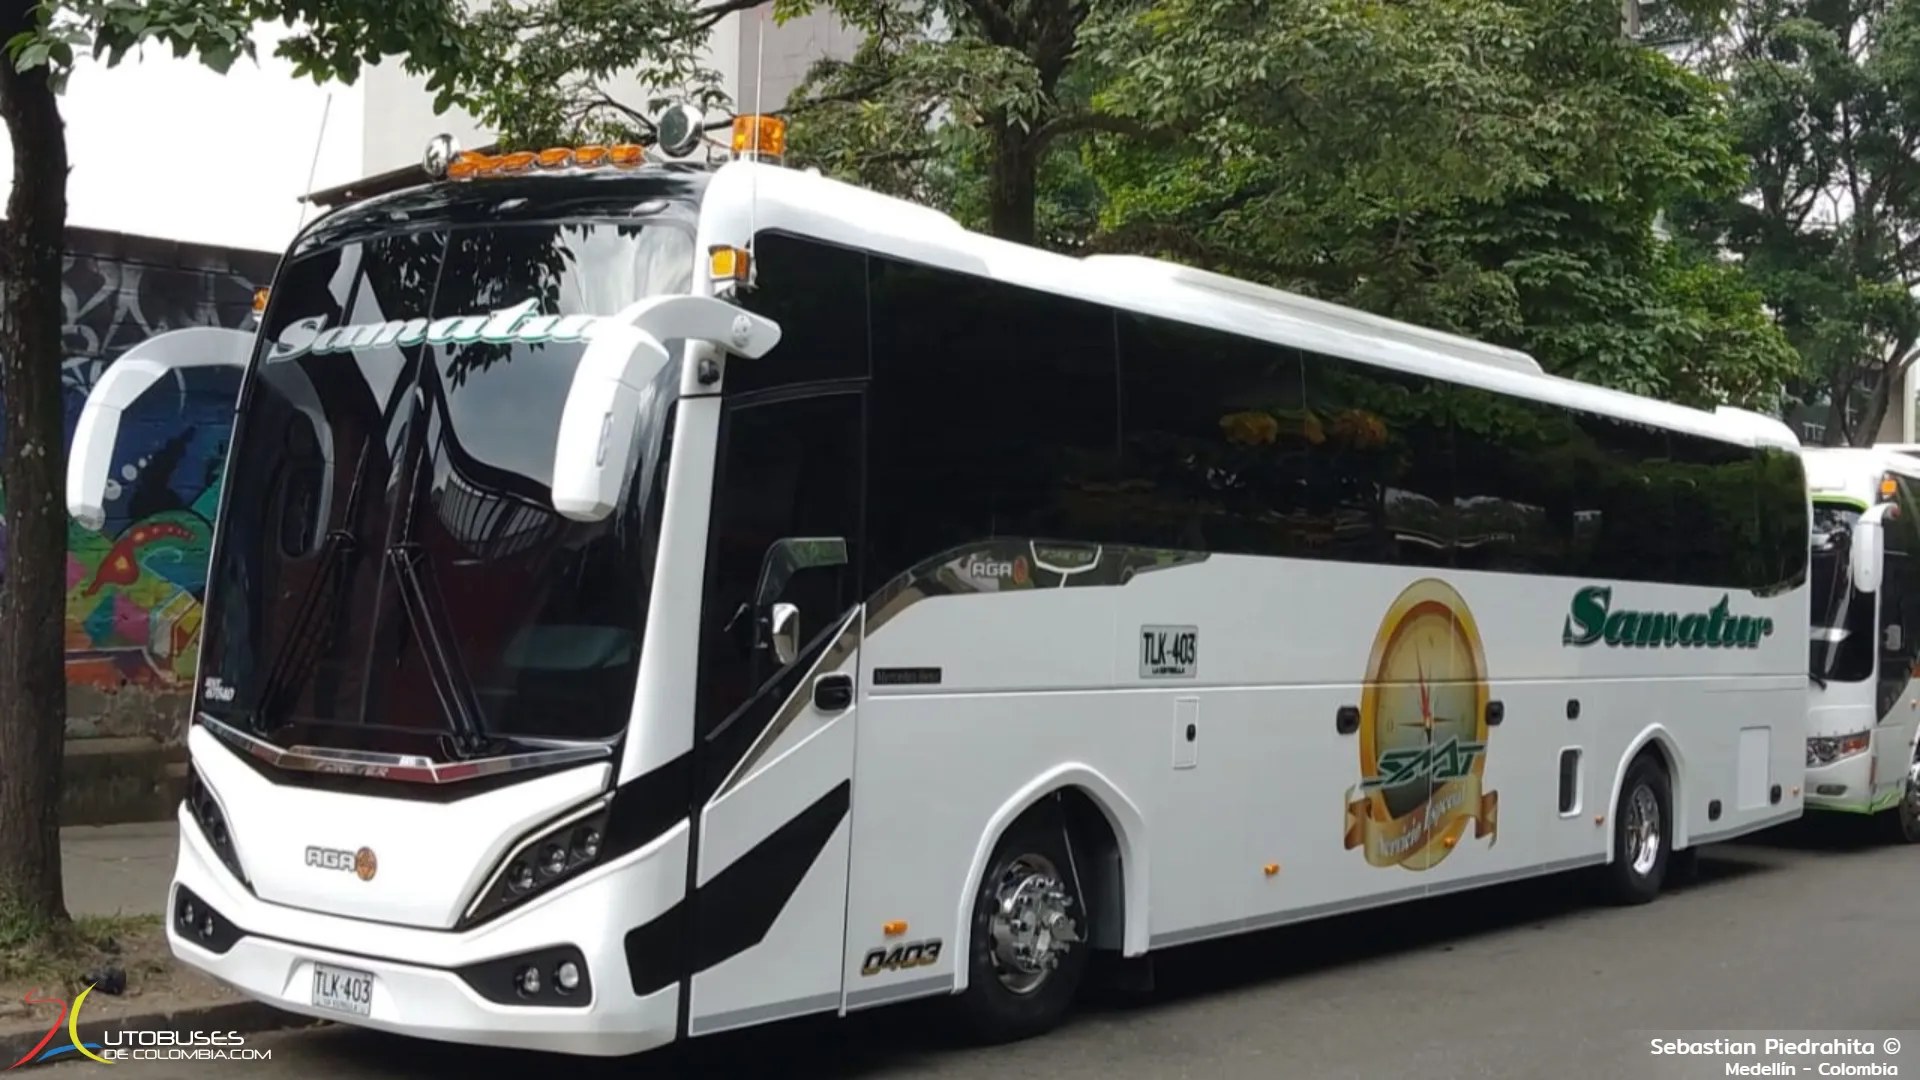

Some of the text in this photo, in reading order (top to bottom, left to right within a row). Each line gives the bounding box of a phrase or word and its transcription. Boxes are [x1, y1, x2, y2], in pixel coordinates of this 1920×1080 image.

[267, 298, 605, 364] Samatu
[971, 562, 1012, 578] AGA
[1562, 585, 1773, 648] Samatur
[1143, 632, 1195, 665] TLK-403
[305, 846, 356, 872] AGA
[862, 938, 942, 977] 0403
[316, 971, 370, 1003] TLK-403
